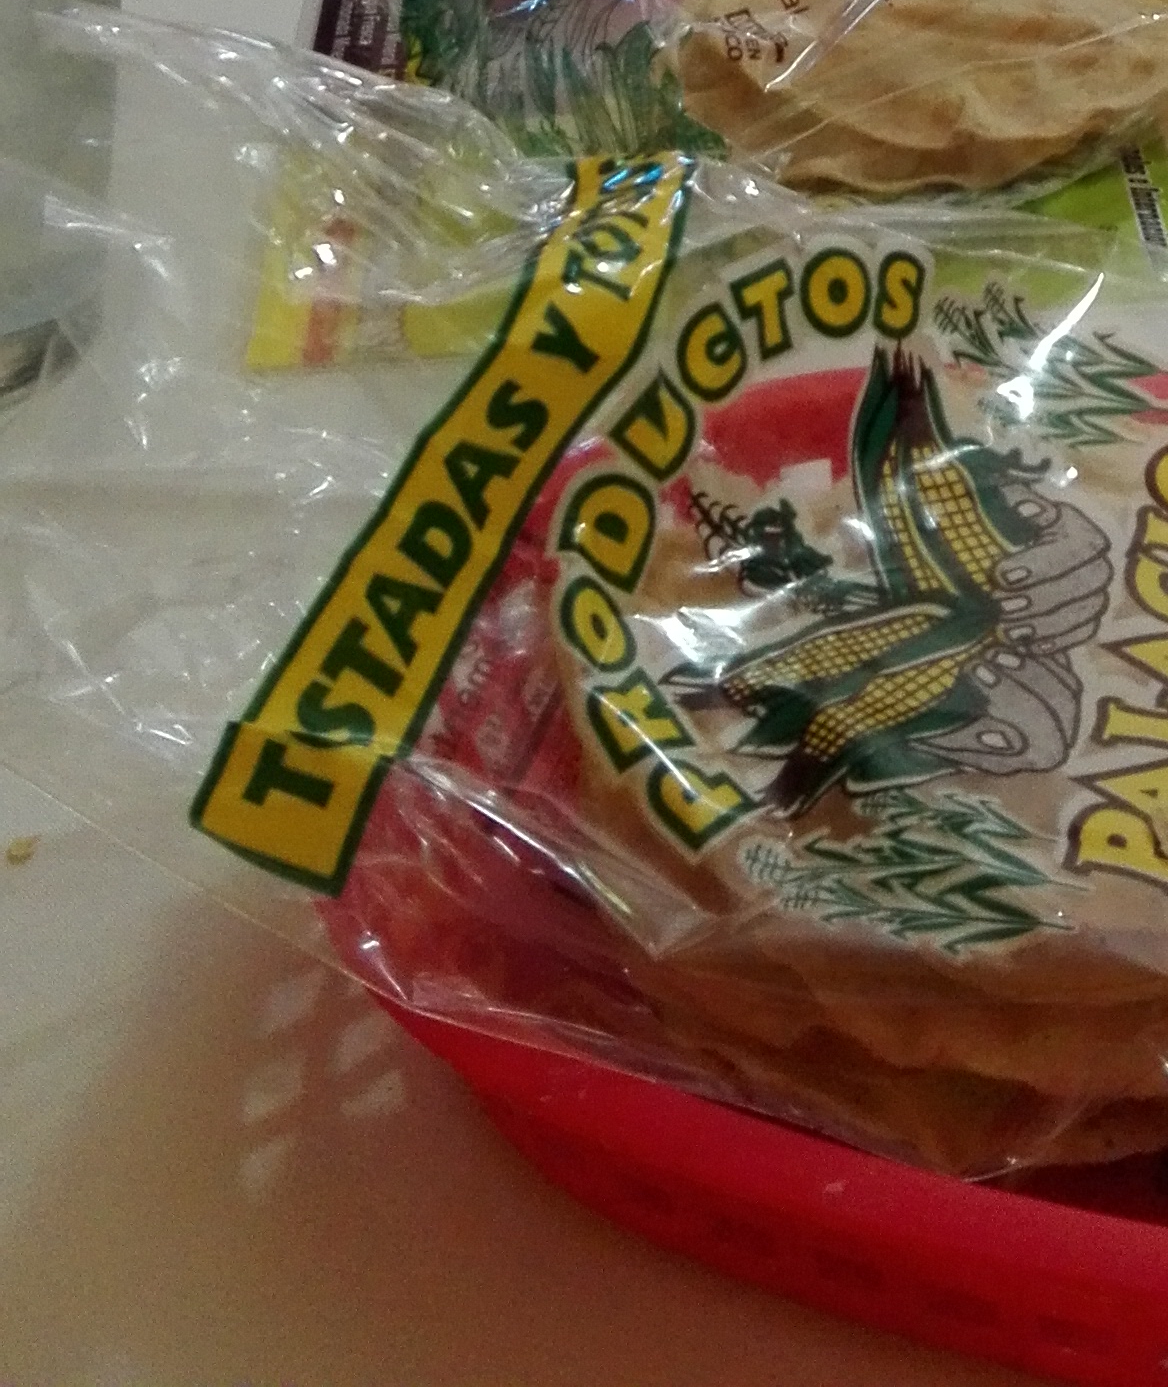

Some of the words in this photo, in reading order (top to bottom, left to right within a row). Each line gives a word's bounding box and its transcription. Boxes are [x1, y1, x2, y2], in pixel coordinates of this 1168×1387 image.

[240, 380, 552, 810] TSTADAS
[530, 300, 601, 375] Y
[557, 248, 926, 849] PRODUCTOS
